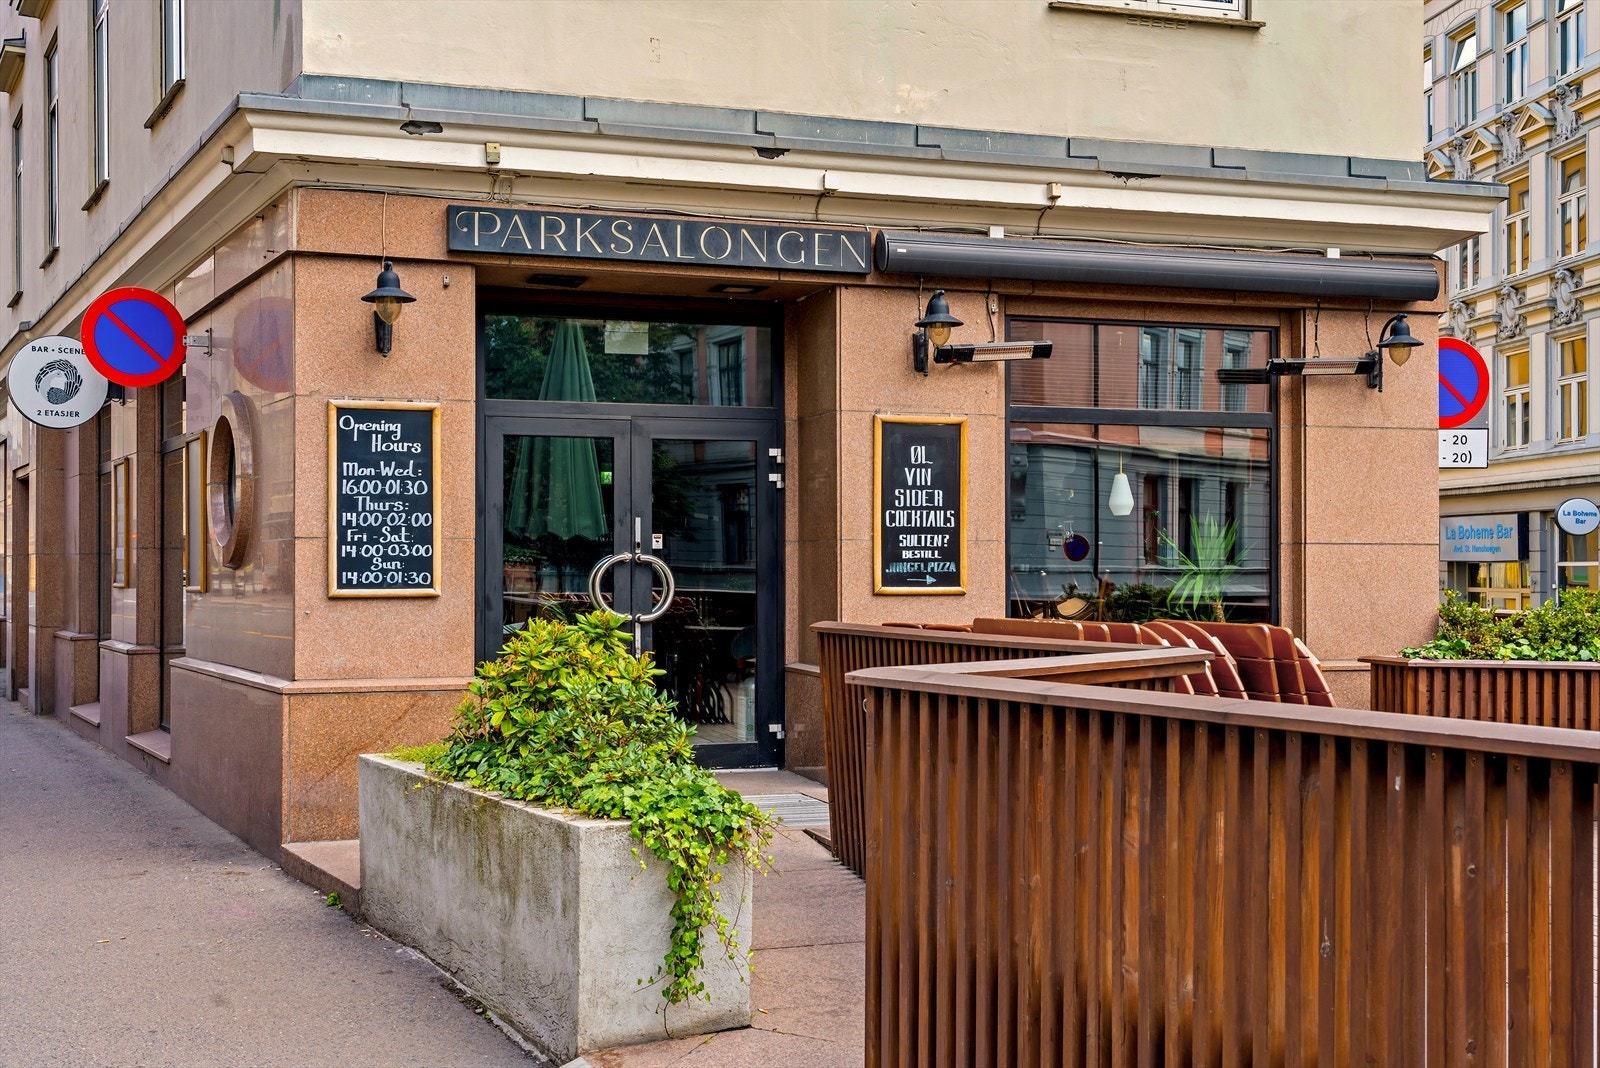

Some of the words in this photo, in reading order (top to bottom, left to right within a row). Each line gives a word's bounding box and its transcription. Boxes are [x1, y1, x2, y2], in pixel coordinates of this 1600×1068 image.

[455, 210, 867, 269] PARKSALONGEN
[31, 345, 49, 353] BAR
[44, 409, 80, 418] ETASJER
[339, 415, 402, 442] Opening
[371, 433, 422, 453] Hours
[1452, 434, 1468, 445] 20
[910, 445, 934, 465] ØL
[1452, 450, 1472, 464] 20)
[904, 467, 932, 486] VIN
[353, 495, 410, 512] Thurs:
[894, 488, 944, 507] SIDER
[885, 510, 955, 528] COCKTAILS
[1575, 517, 1587, 525] Bar
[1445, 527, 1456, 540] La
[1458, 525, 1494, 540] Boheme
[1496, 523, 1514, 539] Bar
[899, 534, 950, 548] SULTEN?
[902, 549, 942, 559] BESTILL
[370, 557, 405, 571] Sun:
